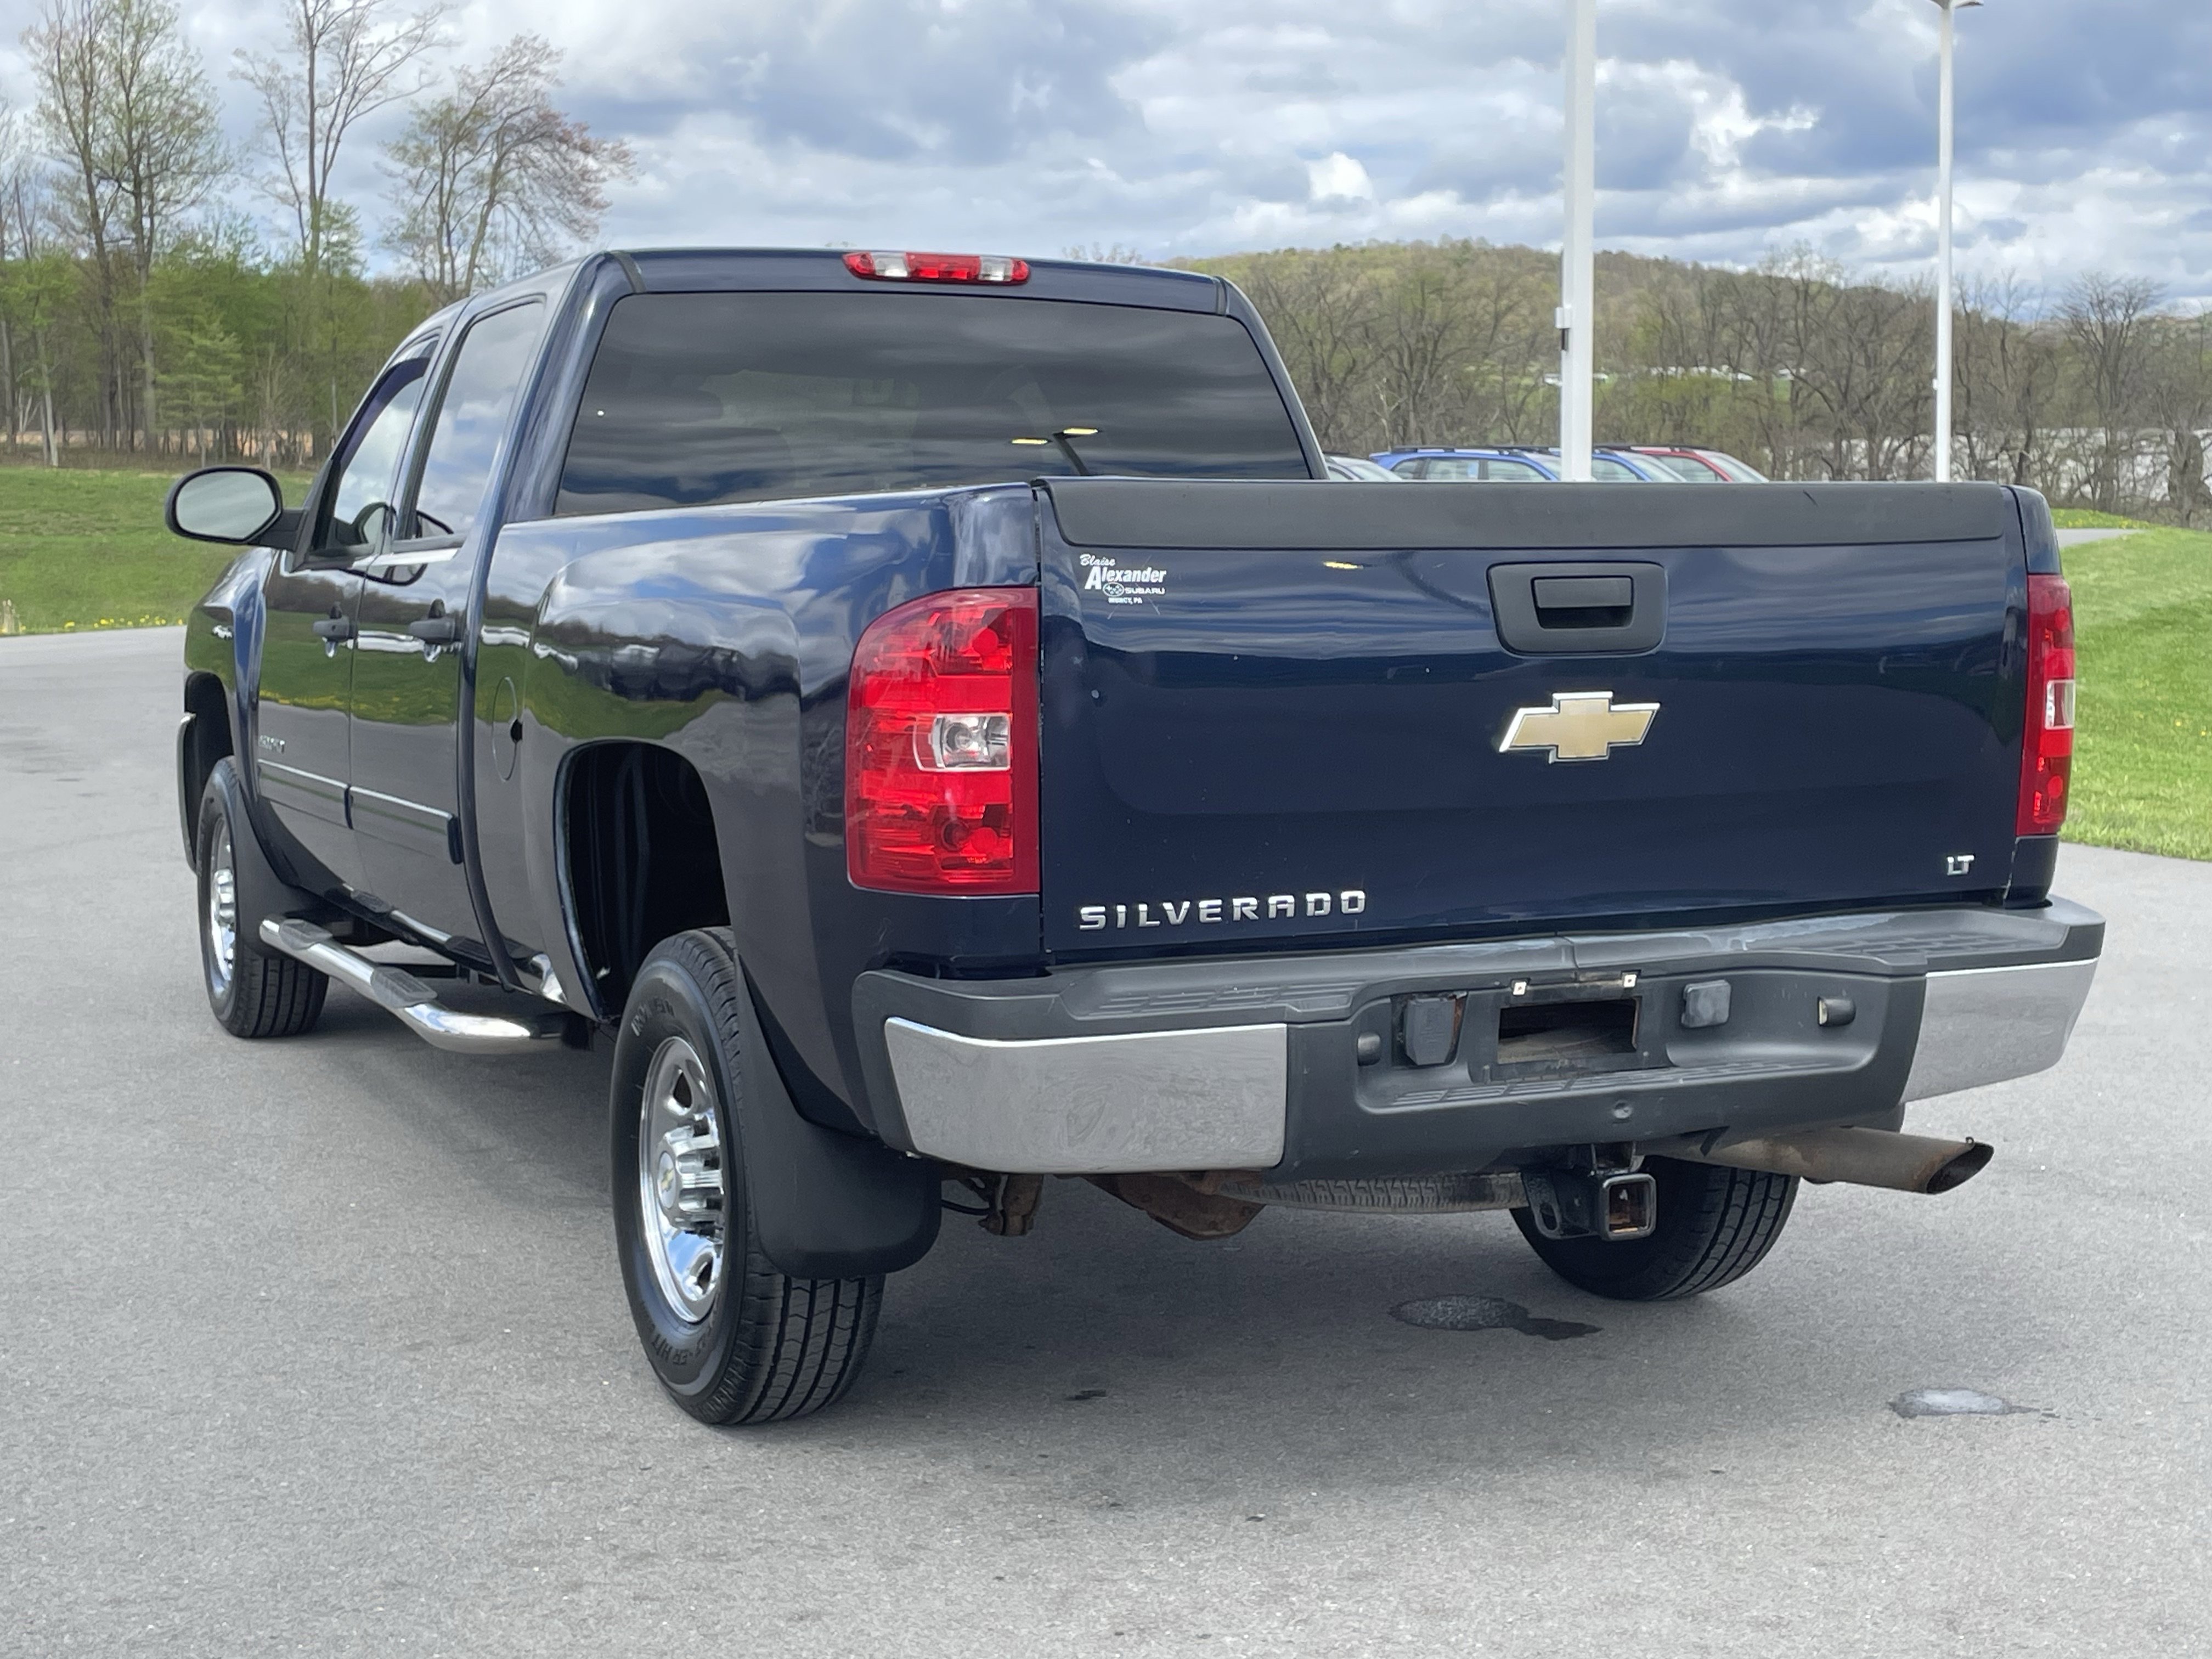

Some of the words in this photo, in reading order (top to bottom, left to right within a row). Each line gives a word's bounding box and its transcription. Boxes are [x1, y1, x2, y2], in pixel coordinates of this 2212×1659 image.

[1079, 554, 1116, 566] Blaise
[1084, 566, 1167, 590] Alexander
[1946, 855, 1974, 876] LT
[1079, 890, 1366, 930] SILVERADO
